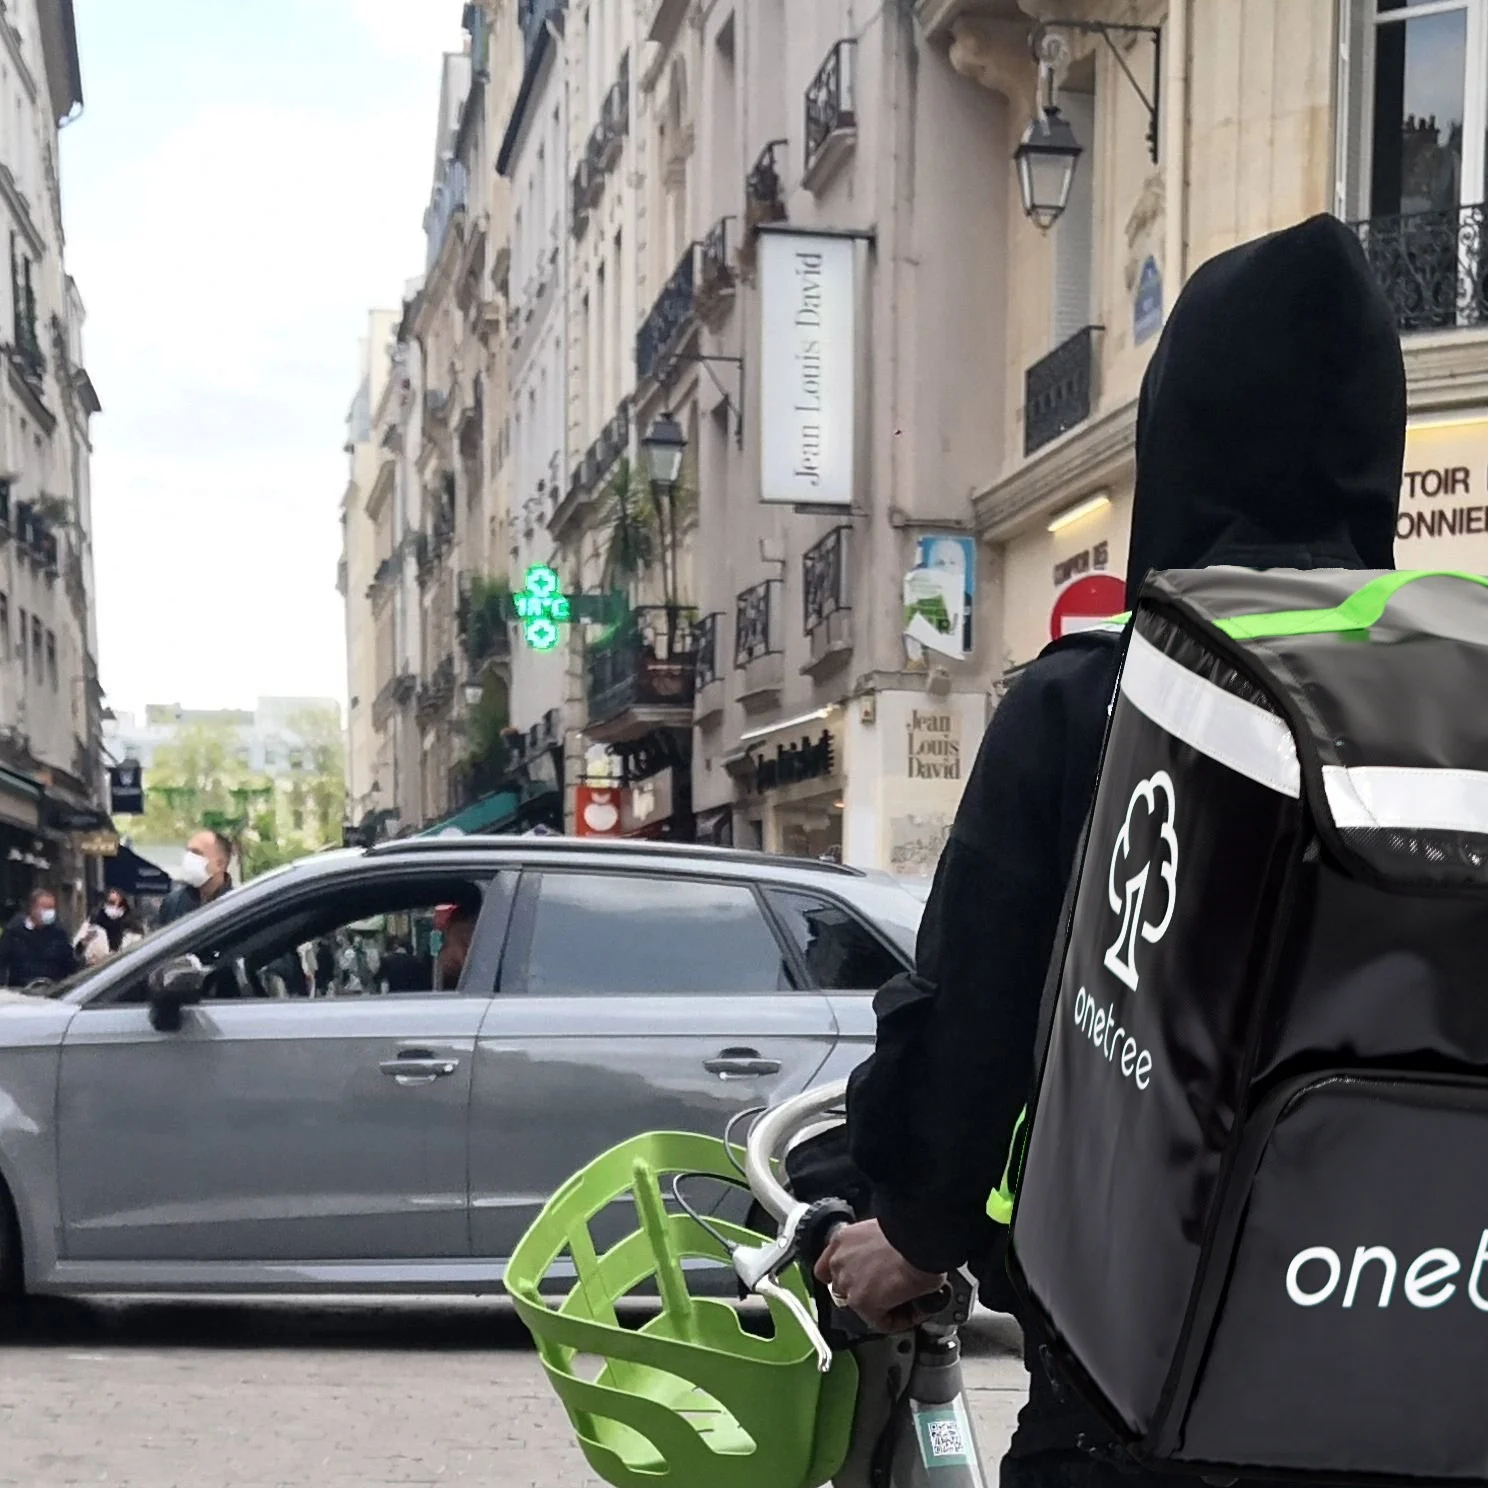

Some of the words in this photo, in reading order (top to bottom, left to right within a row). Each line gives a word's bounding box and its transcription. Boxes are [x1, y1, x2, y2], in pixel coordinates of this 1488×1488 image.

[794, 252, 822, 327] David
[793, 340, 820, 411] Louis
[793, 425, 820, 486] Jean
[1404, 466, 1470, 499] TOIR
[906, 709, 951, 732] Jean
[907, 732, 960, 756] Louis
[907, 756, 961, 780] David
[1074, 985, 1153, 1090] onetree
